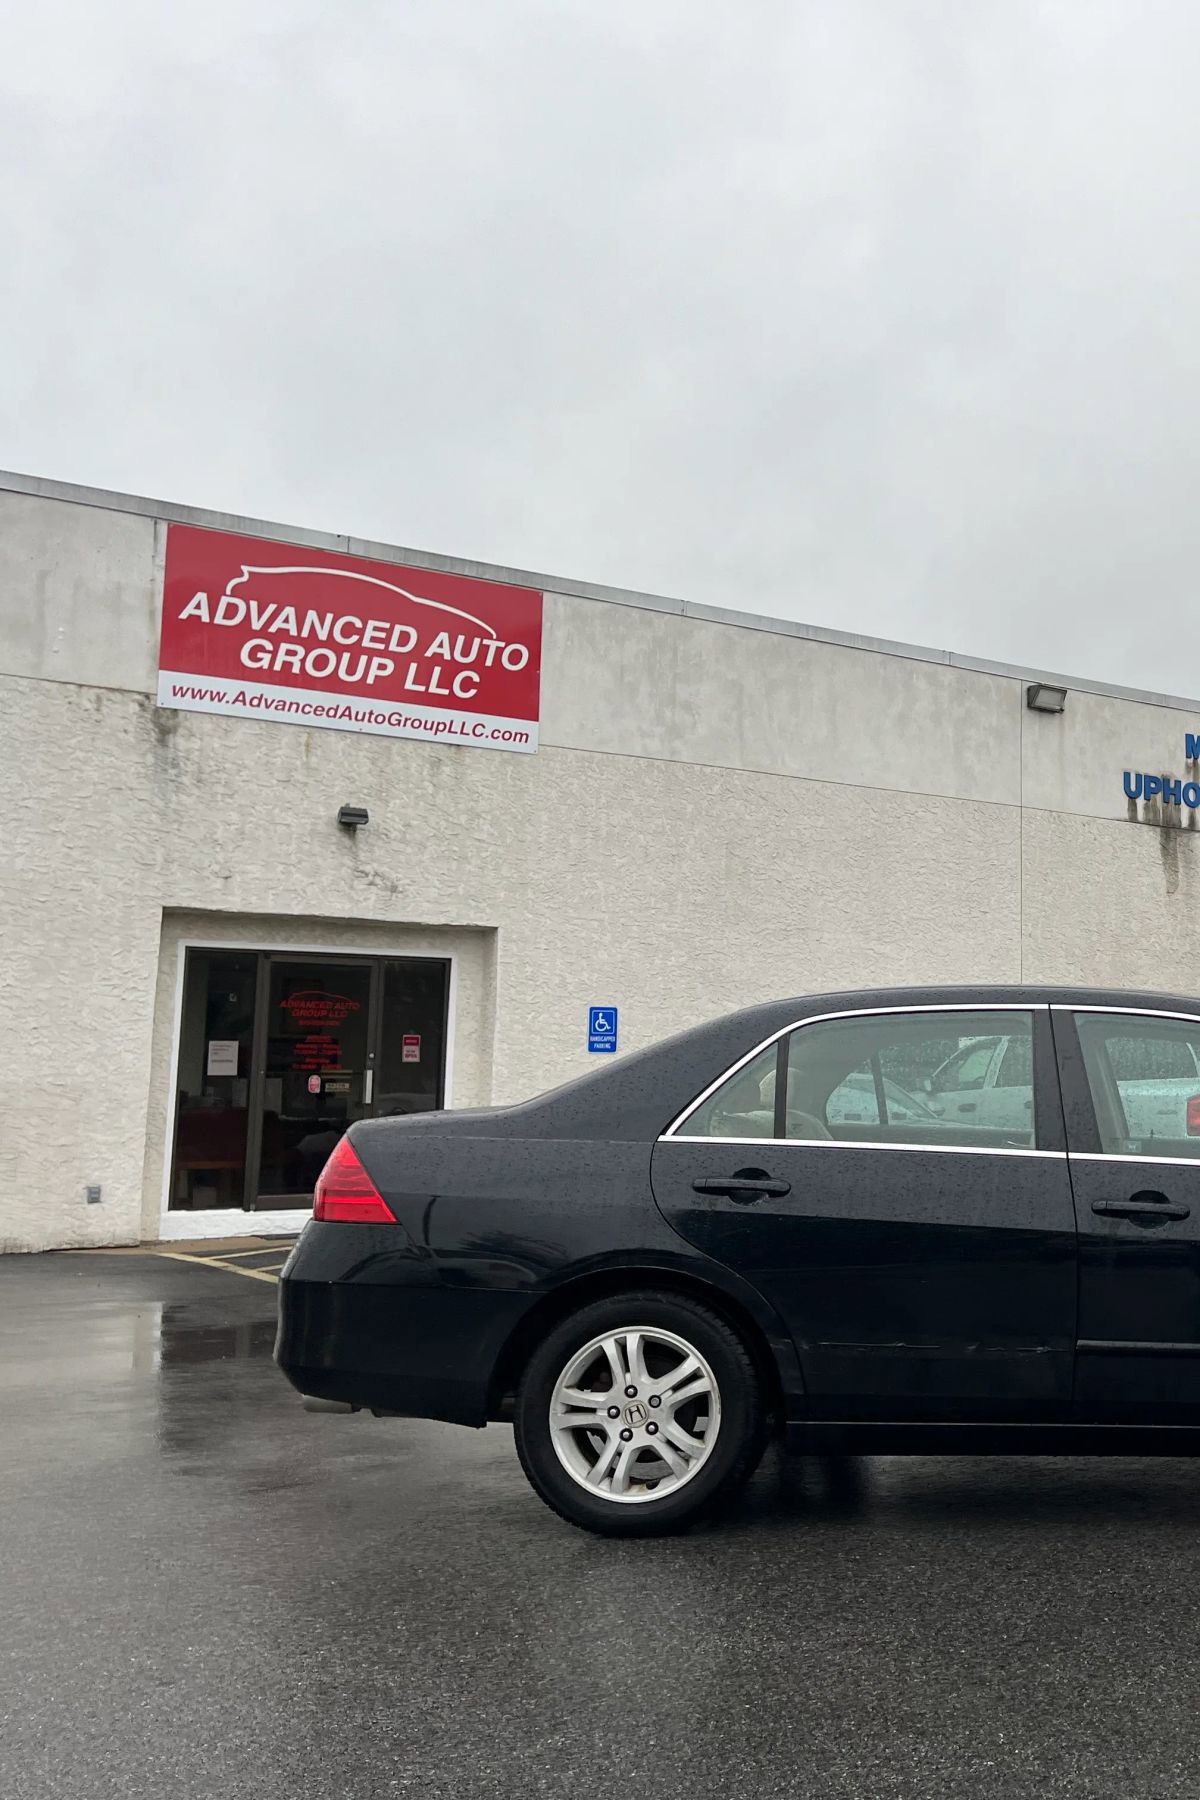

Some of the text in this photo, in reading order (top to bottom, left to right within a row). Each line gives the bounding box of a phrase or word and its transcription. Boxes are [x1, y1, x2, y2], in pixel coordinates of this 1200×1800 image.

[178, 592, 529, 671] ADVANCED AUTO
[240, 638, 480, 699] GROUP LLC
[171, 684, 530, 744] www.AdvancedAutoGroupLLC.com
